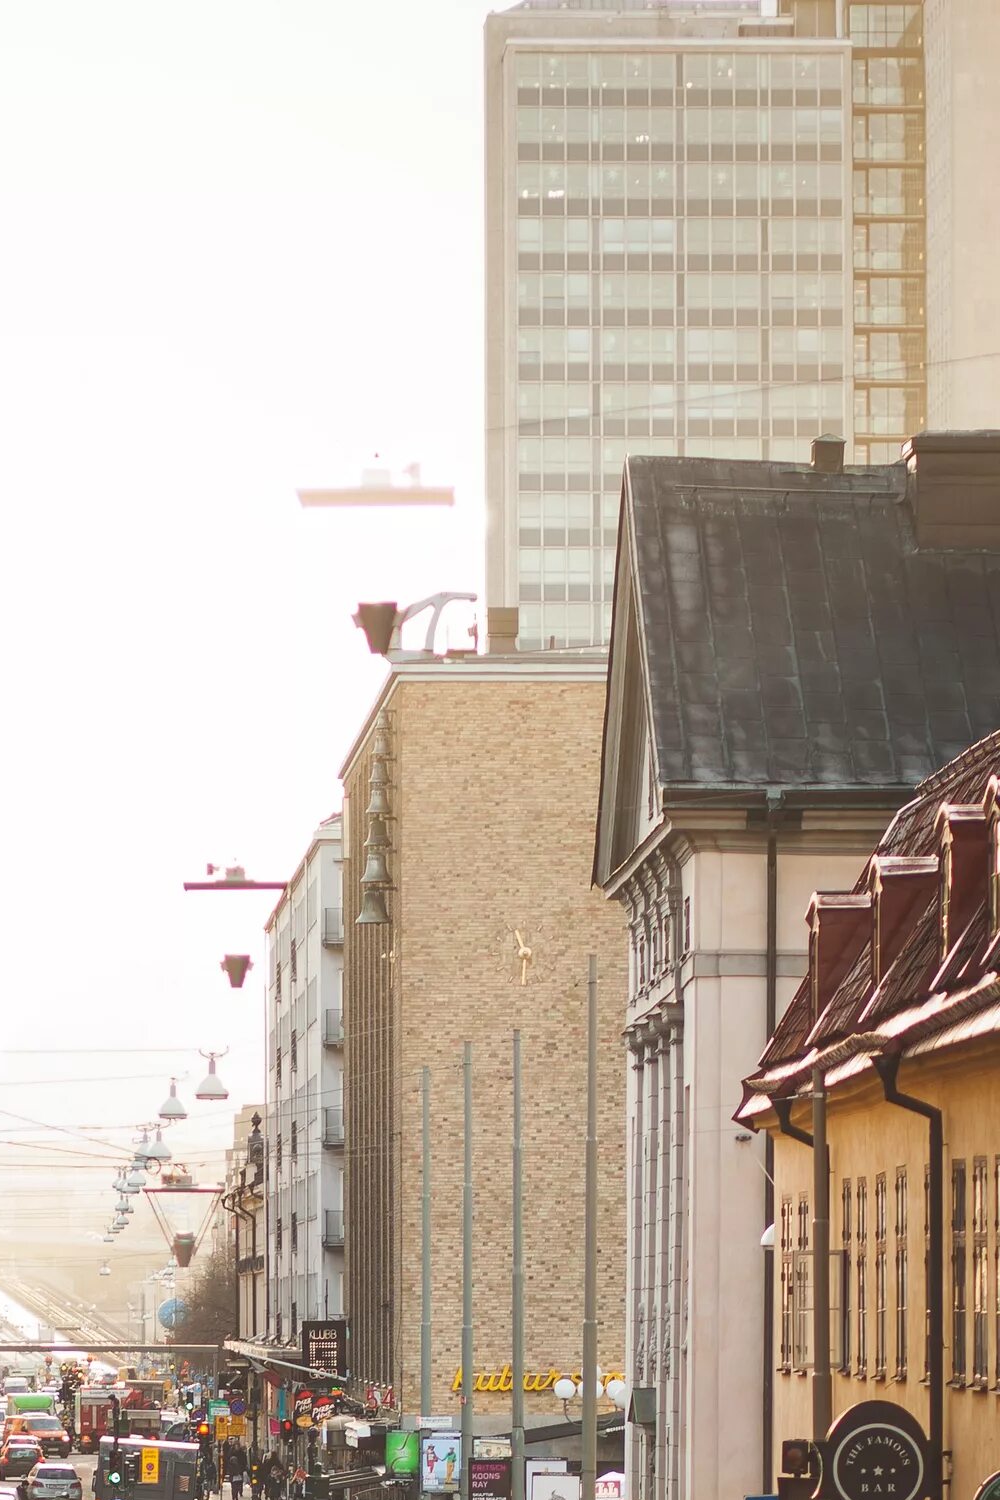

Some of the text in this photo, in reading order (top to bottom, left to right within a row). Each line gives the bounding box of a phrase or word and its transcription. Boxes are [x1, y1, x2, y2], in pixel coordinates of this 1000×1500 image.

[309, 1328, 338, 1340] KLUBB
[846, 1435, 911, 1467] THE FAMOUS
[472, 1472, 501, 1480] KOONS
[472, 1480, 488, 1488] RAY
[861, 1483, 897, 1493] BAR
